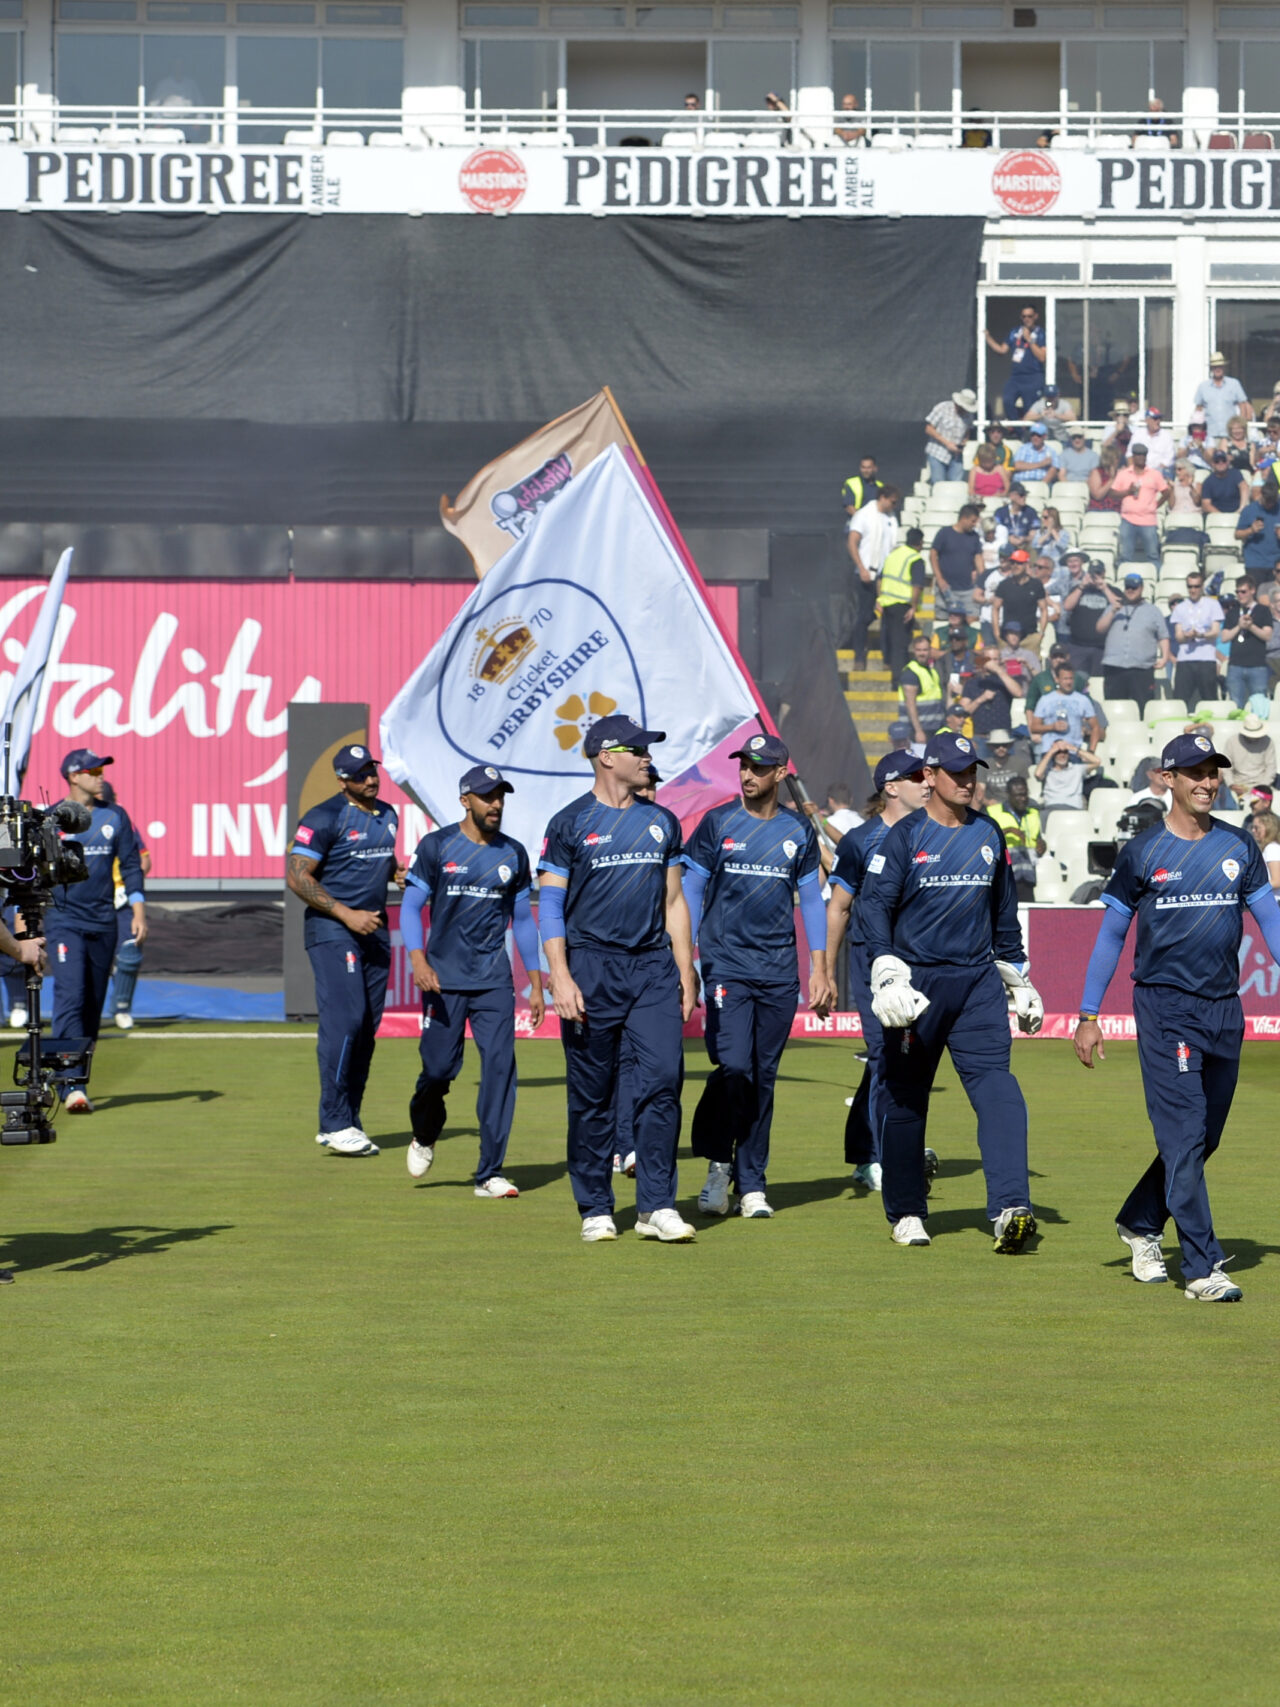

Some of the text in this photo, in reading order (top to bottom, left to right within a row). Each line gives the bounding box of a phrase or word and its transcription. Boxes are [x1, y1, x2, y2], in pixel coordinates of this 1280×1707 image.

[24, 152, 303, 205] PEDIGREE
[311, 155, 325, 206] AMBER
[327, 177, 340, 206] ALE
[562, 155, 838, 207] PEDIGREE
[845, 156, 858, 208] AMBER
[861, 179, 874, 208] ALE
[467, 607, 554, 703] 18 70
[506, 650, 559, 701] Cricket
[488, 630, 610, 750] DERBYSHIRE
[804, 1016, 834, 1032] LIFE
